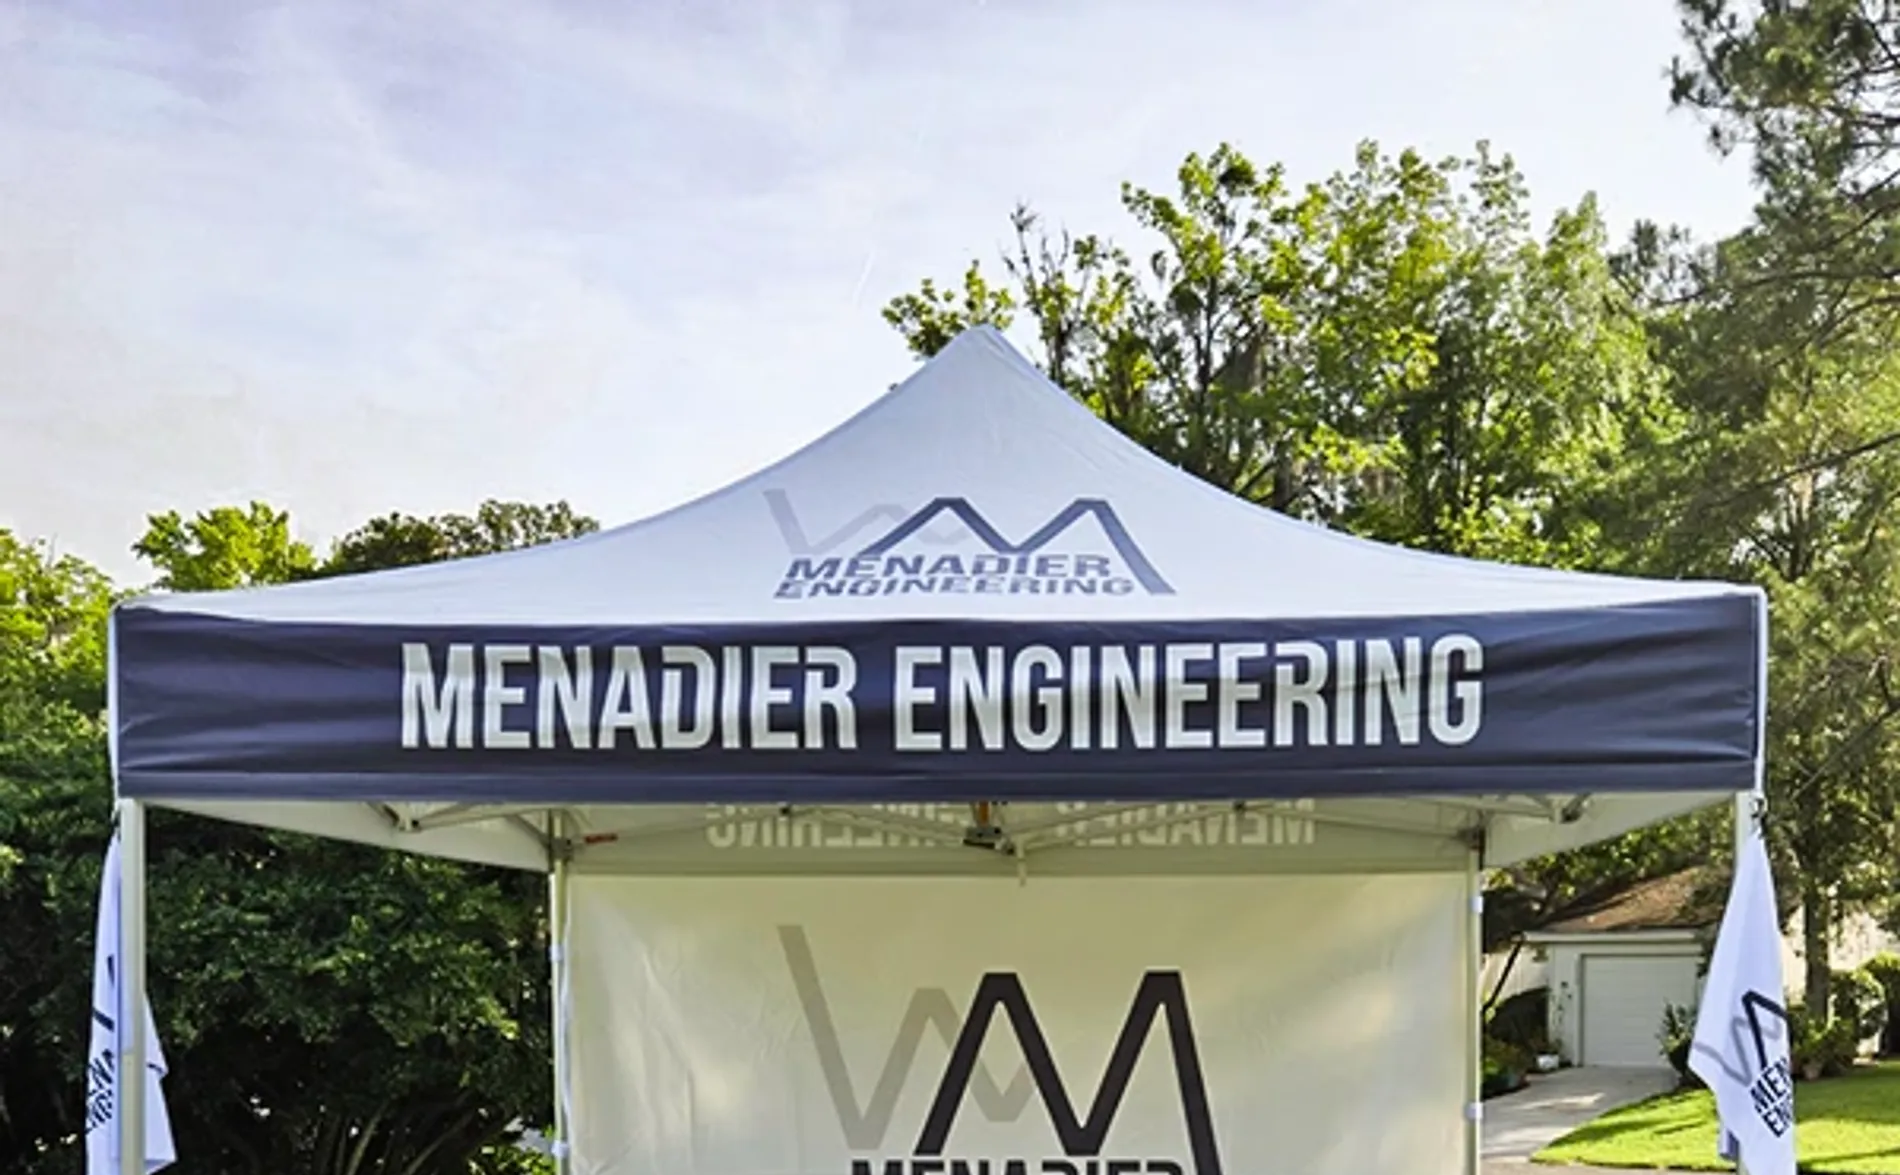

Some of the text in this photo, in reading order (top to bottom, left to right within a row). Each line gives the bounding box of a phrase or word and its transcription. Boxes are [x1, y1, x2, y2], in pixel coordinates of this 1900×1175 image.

[784, 553, 1110, 580] MENADIER
[773, 576, 1135, 599] ENGINEERING
[401, 634, 1484, 751] MENADIER ENGINEERING
